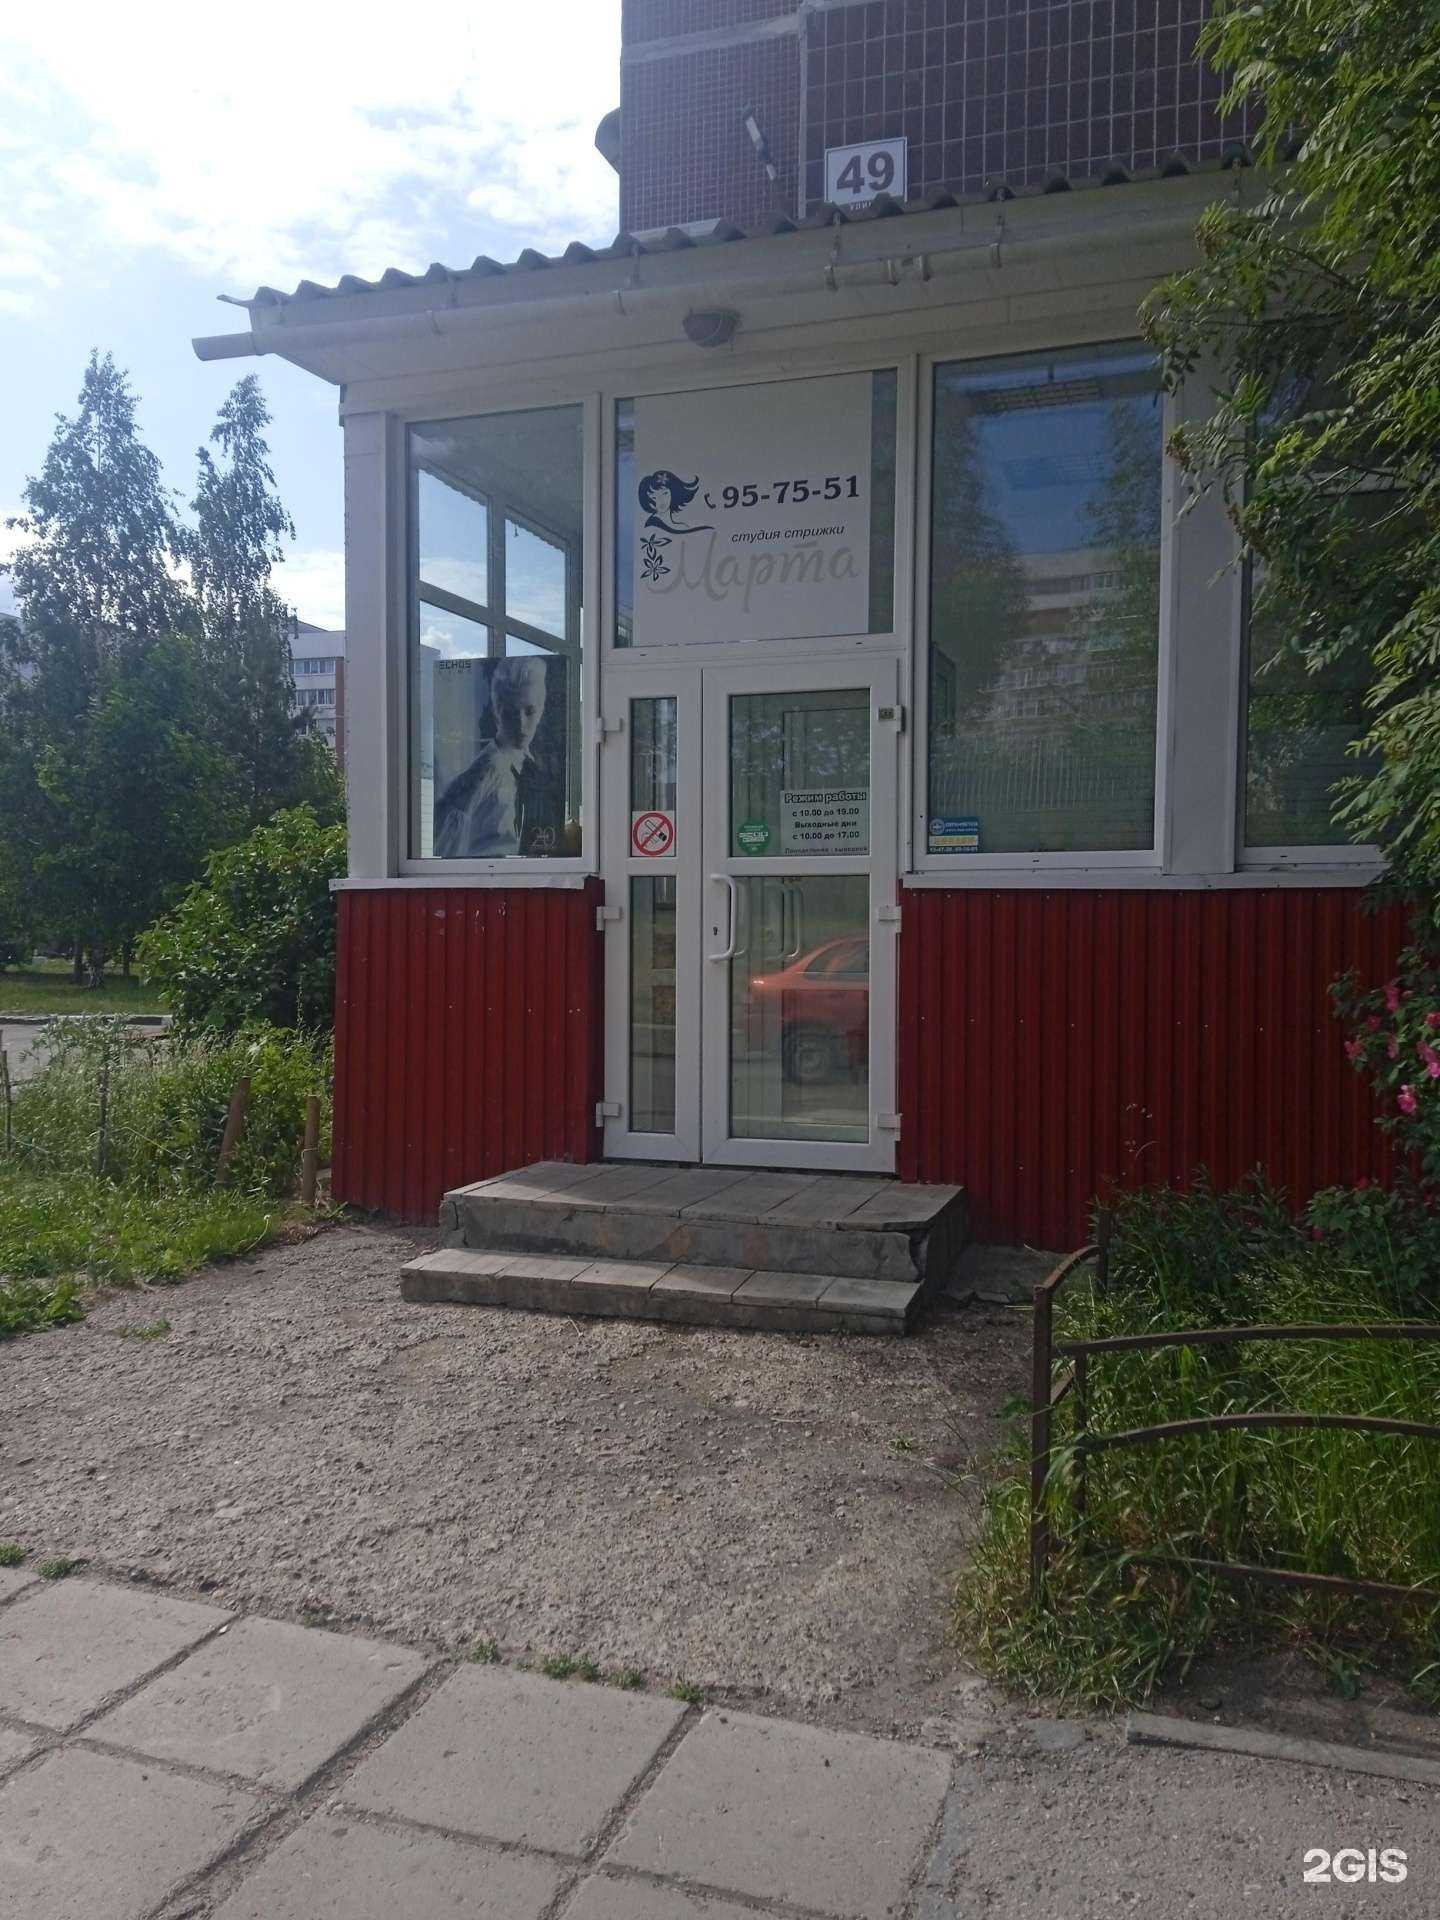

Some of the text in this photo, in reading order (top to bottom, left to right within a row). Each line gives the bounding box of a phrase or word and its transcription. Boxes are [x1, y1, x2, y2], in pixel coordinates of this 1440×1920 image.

[836, 151, 896, 194] 49
[722, 475, 859, 508] 95-75-51
[731, 525, 844, 544] студия стрижки
[647, 532, 858, 613] Марта
[784, 791, 867, 804] Режим работы
[795, 821, 857, 829] Выходные дни
